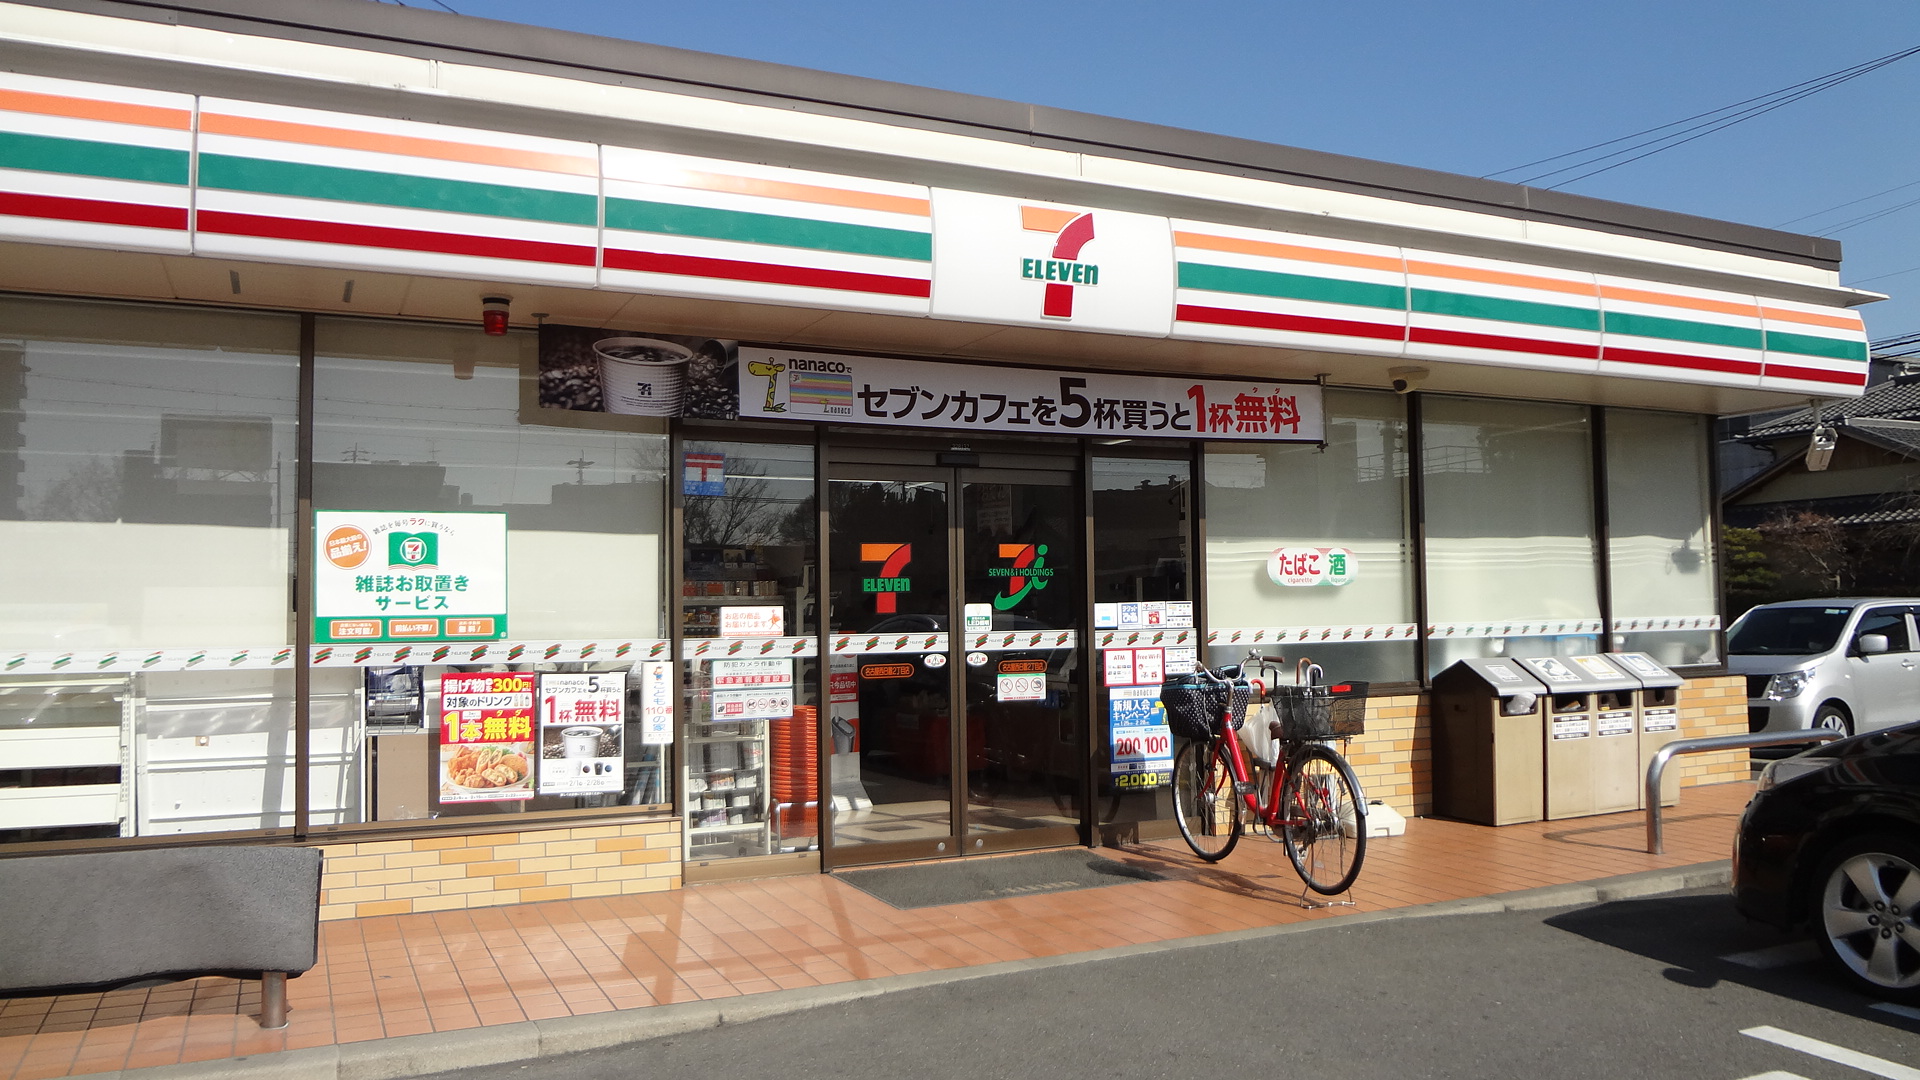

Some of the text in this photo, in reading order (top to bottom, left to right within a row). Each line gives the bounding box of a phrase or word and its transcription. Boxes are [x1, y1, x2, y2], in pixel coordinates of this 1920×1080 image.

[1279, 553, 1346, 576] たばこ 酒
[1019, 568, 1054, 577] HOLDINGS
[355, 575, 470, 593] 雑誌お取置き
[375, 596, 450, 611] サービス
[723, 660, 783, 668] 防犯カメラ作動中
[446, 696, 512, 708] 対象のドリンク
[545, 695, 621, 723] 1杯無料
[1113, 699, 1151, 712] 新規入会
[1113, 711, 1151, 721] キャンペーン
[444, 711, 531, 742] 1本無料
